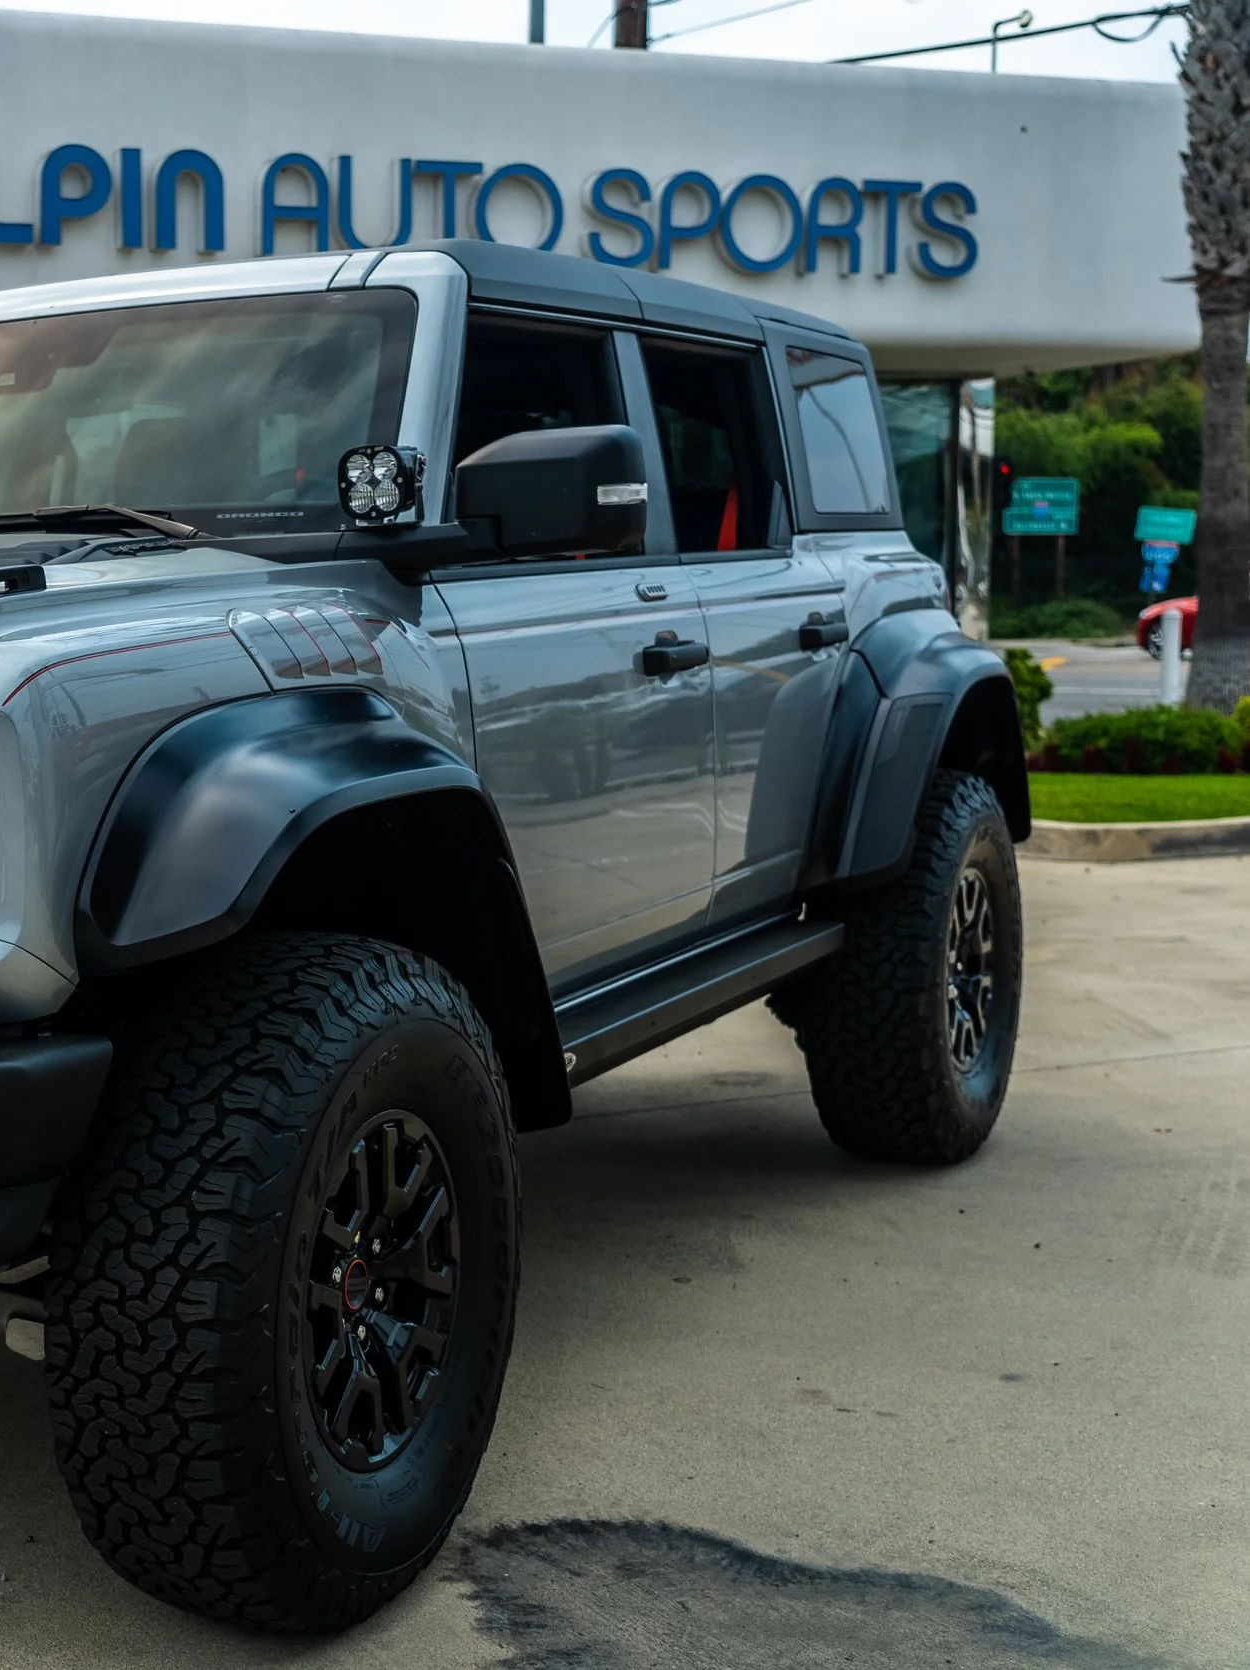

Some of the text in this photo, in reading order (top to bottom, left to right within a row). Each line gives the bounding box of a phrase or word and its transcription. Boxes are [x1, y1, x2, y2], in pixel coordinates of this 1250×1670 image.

[261, 152, 564, 255] AUTO
[588, 168, 978, 279] SPORTS
[216, 511, 304, 519] BRONCO
